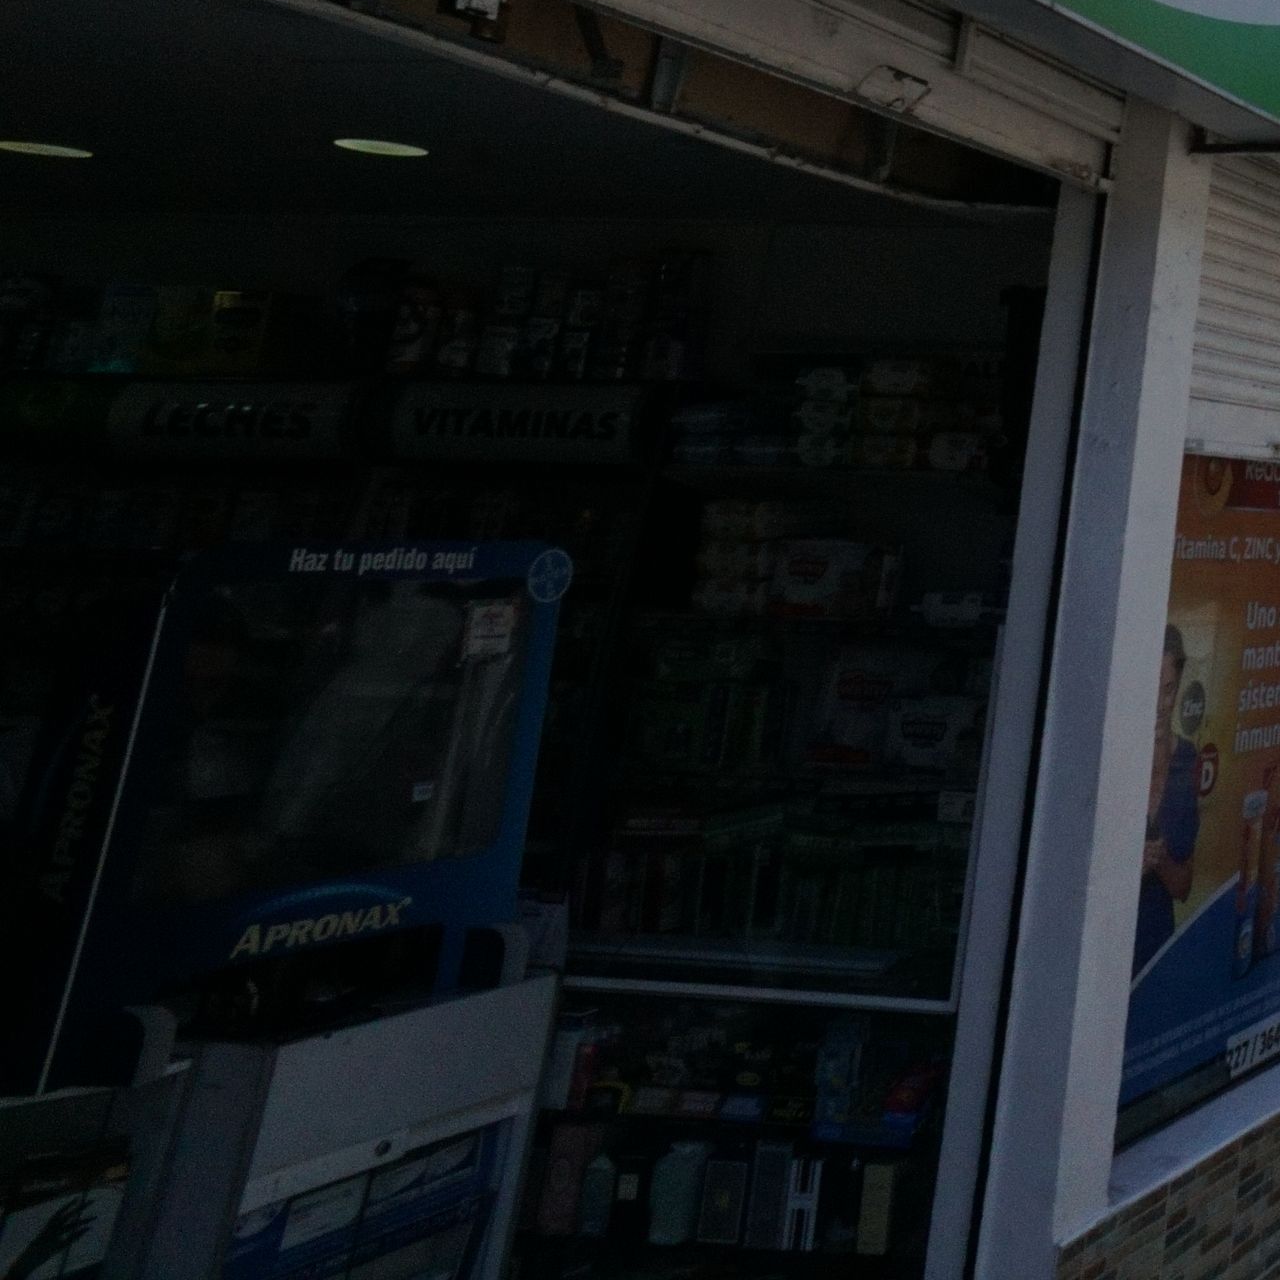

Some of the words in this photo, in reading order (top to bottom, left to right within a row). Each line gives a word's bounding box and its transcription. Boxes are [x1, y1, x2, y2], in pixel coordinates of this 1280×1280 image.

[141, 399, 313, 439] LECHES
[413, 407, 620, 443] VITAMINAS
[289, 545, 329, 573] Haz
[333, 549, 355, 572] tu
[357, 545, 427, 578] pedido
[430, 544, 479, 577] aquí
[1243, 537, 1273, 561] ZINC
[1247, 600, 1277, 631] Uno
[40, 695, 116, 904] APRONAX
[229, 901, 405, 960] APRONAX
